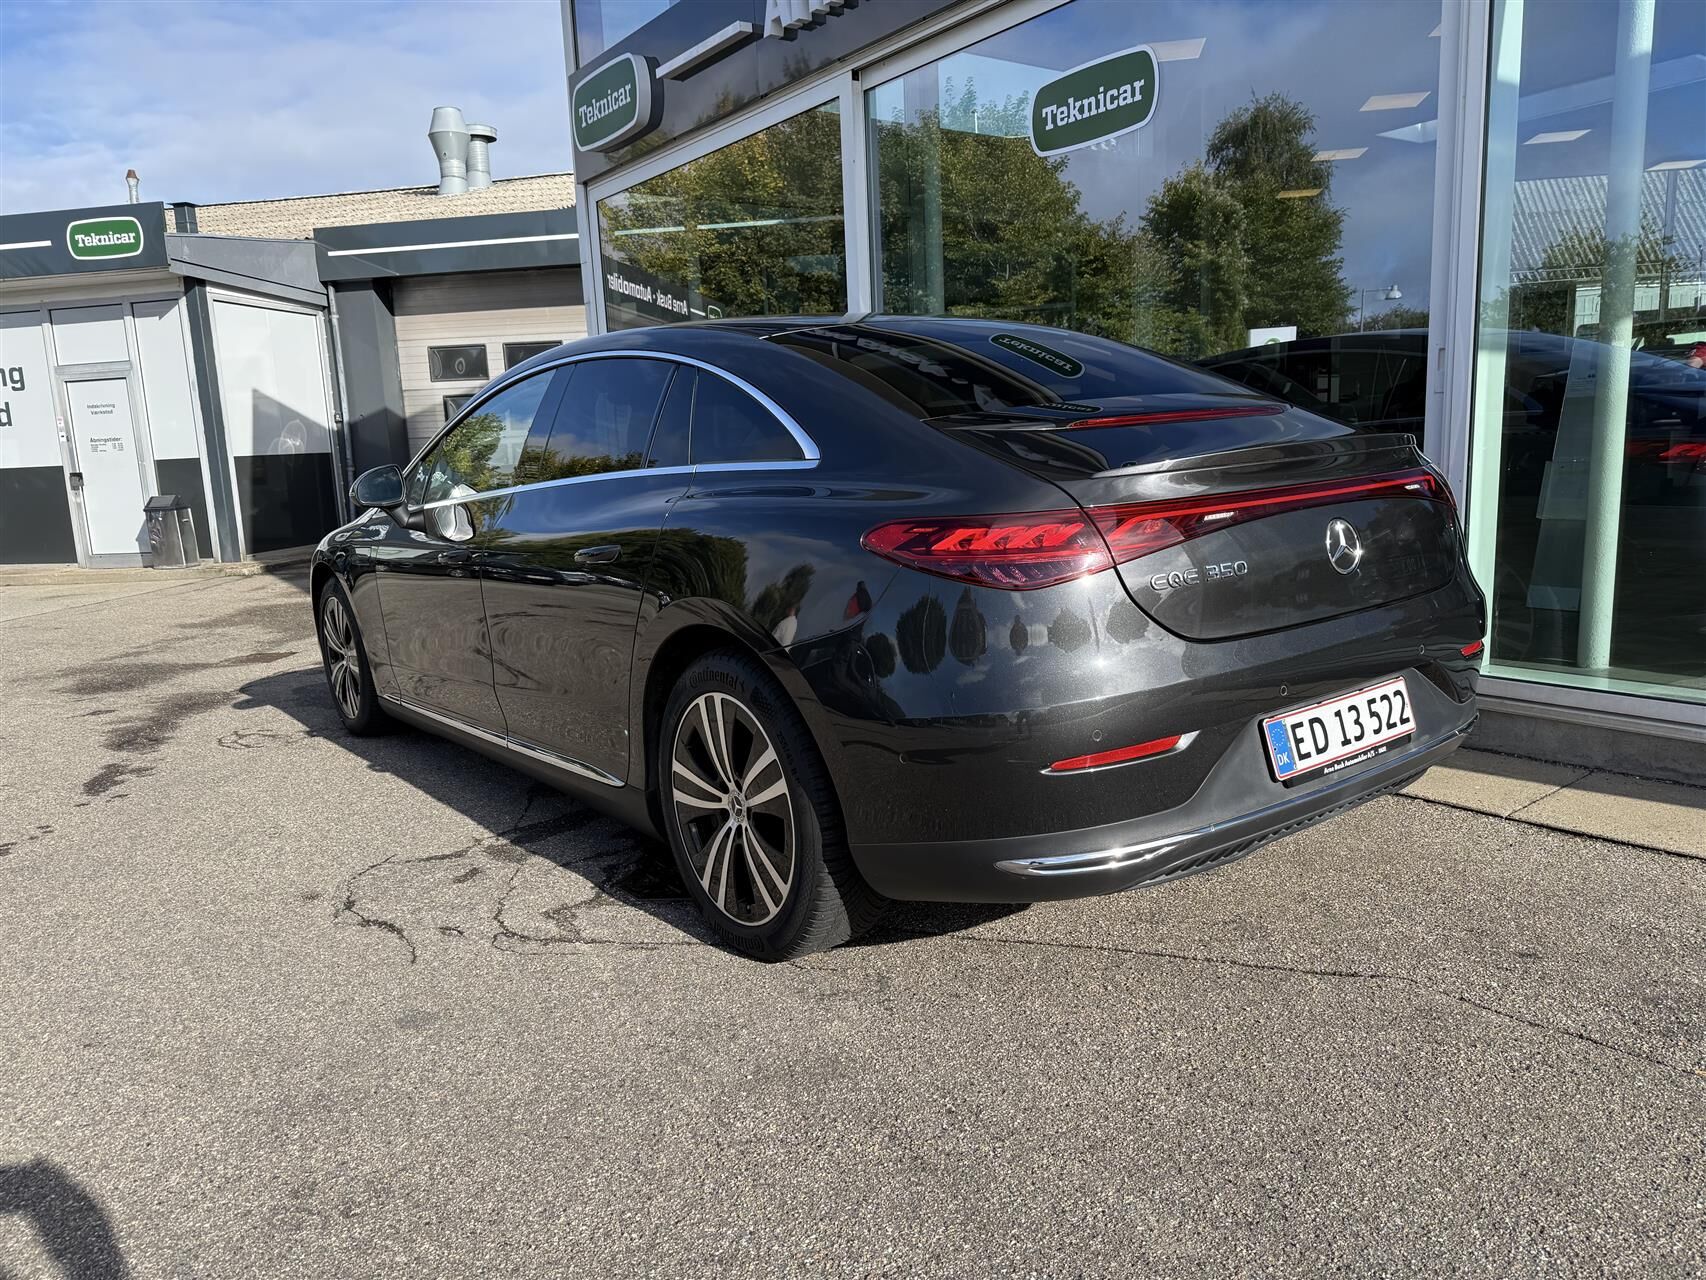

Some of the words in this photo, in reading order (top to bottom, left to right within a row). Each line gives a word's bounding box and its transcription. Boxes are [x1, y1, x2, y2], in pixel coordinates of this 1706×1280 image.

[578, 83, 632, 129] Teknicar
[1042, 79, 1145, 131] Teknicar
[74, 231, 136, 247] Teknicar
[1150, 568, 1200, 591] EQE
[1205, 560, 1248, 581] 350
[689, 666, 738, 690] Continental
[1290, 716, 1329, 762] ED
[1334, 704, 1365, 747] 13
[1366, 689, 1411, 735] 522
[1276, 751, 1290, 766] DK
